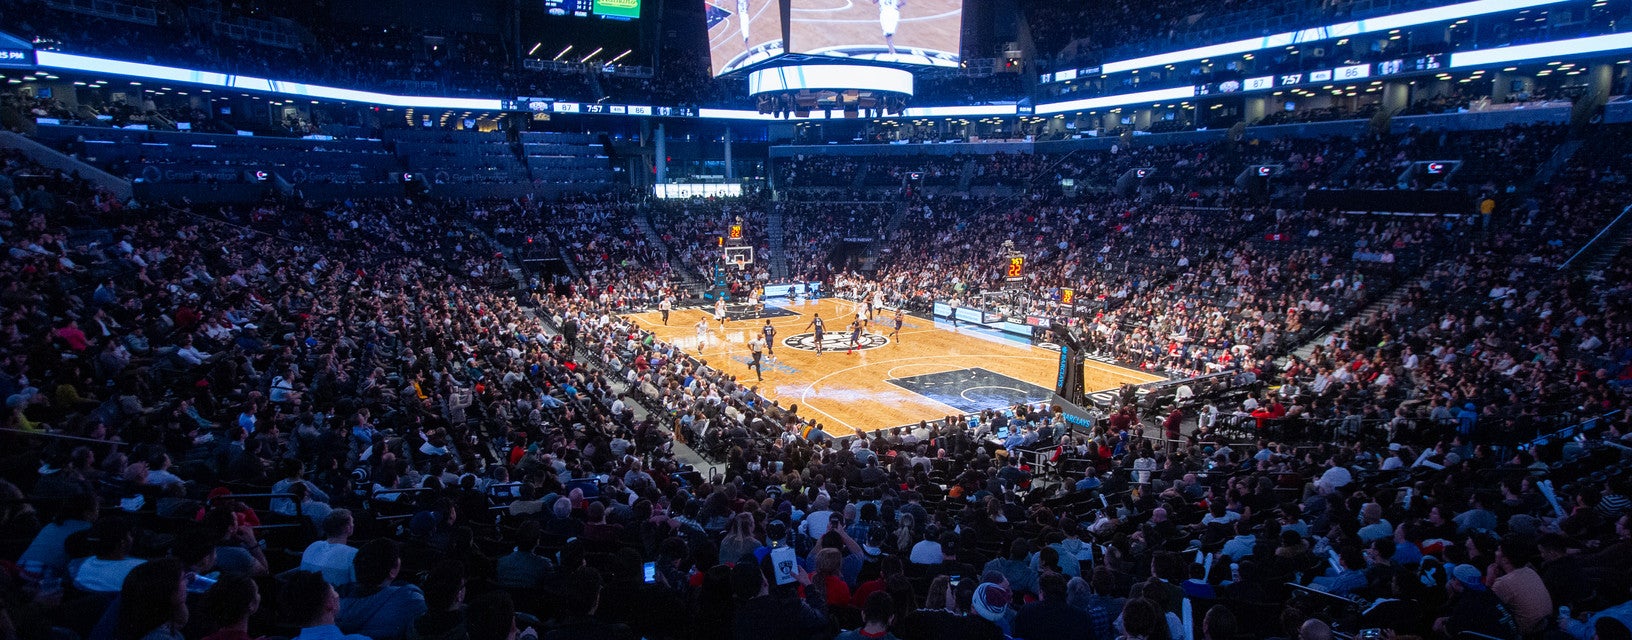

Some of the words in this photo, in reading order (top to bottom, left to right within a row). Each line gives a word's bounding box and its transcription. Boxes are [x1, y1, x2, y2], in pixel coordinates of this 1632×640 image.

[1345, 67, 1358, 77] 86
[1253, 79, 1264, 88] 87
[586, 104, 603, 113] 7:57
[1008, 264, 1021, 276] 22
[1057, 354, 1067, 388] BARCLAYS
[1062, 411, 1091, 428] BARCLAYS
